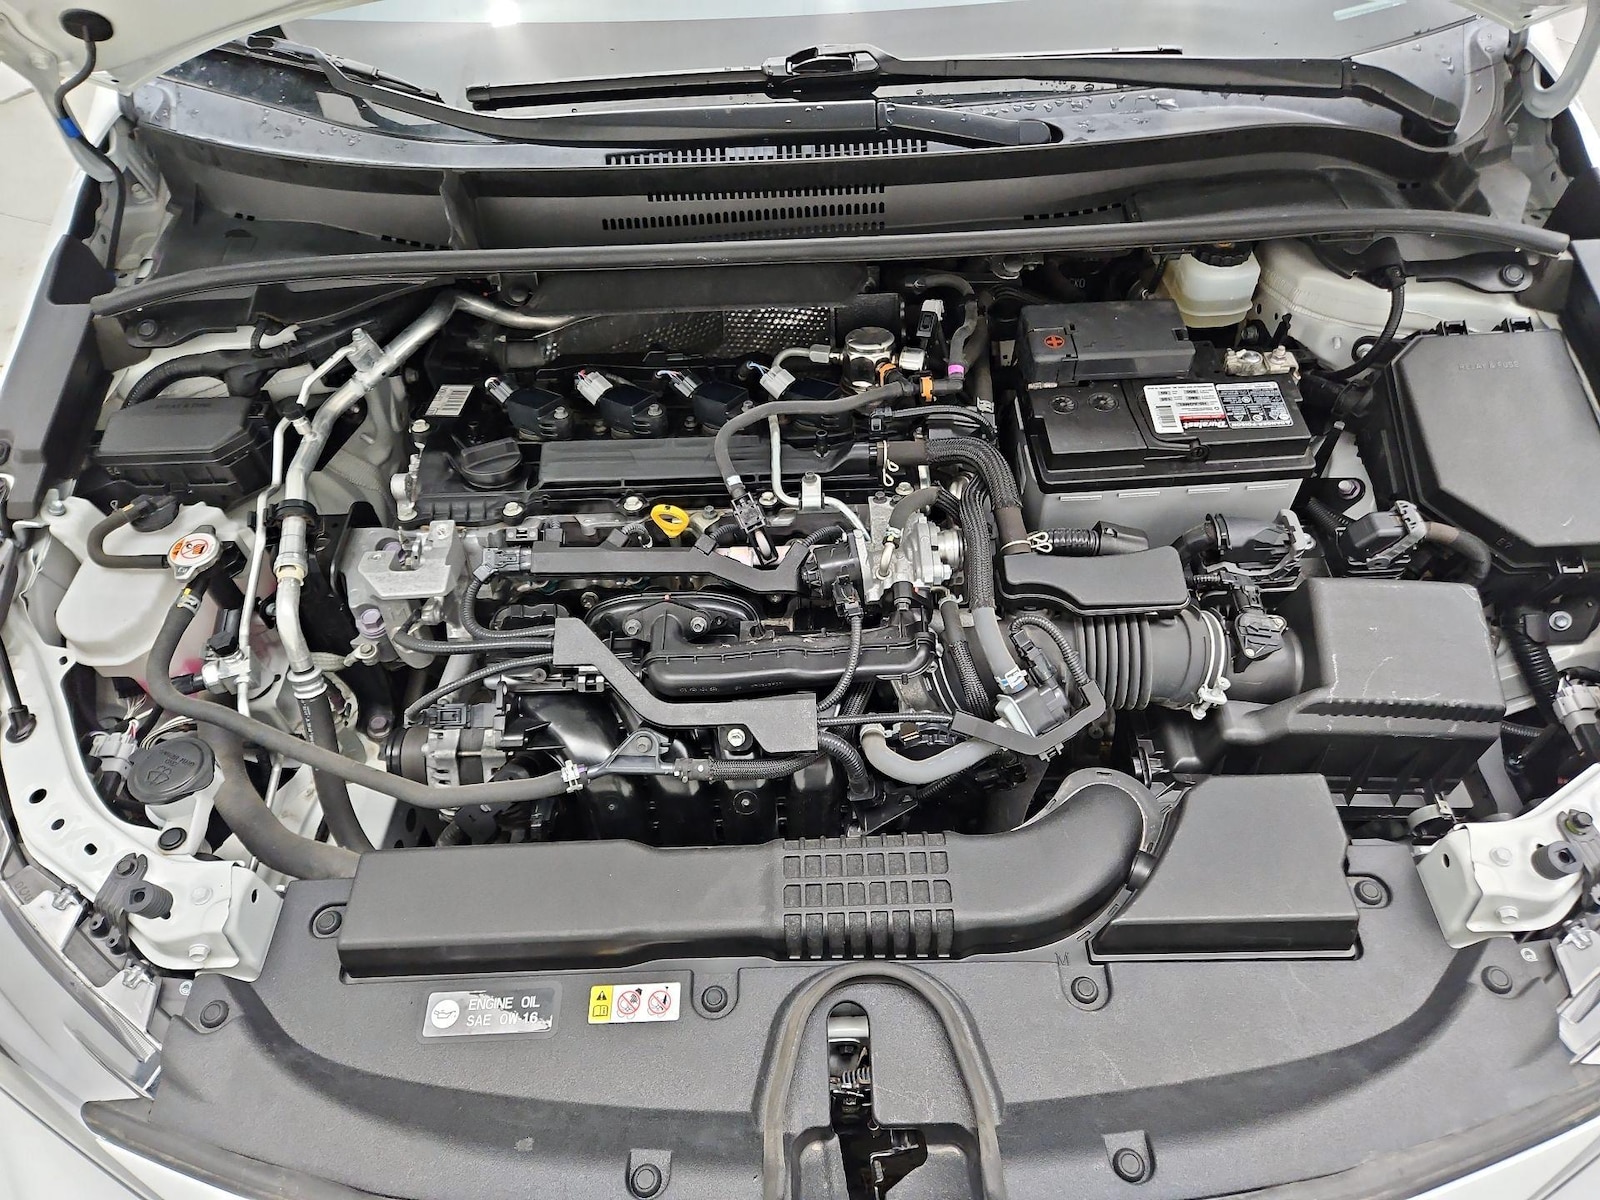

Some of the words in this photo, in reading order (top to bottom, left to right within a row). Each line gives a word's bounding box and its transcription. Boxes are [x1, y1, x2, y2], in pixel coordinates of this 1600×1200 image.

[1183, 421, 1228, 430] Duralast
[468, 997, 513, 1011] ENGINE
[521, 995, 541, 1009] OIL
[466, 1015, 491, 1027] SAE
[499, 1011, 538, 1025] 0W-16
